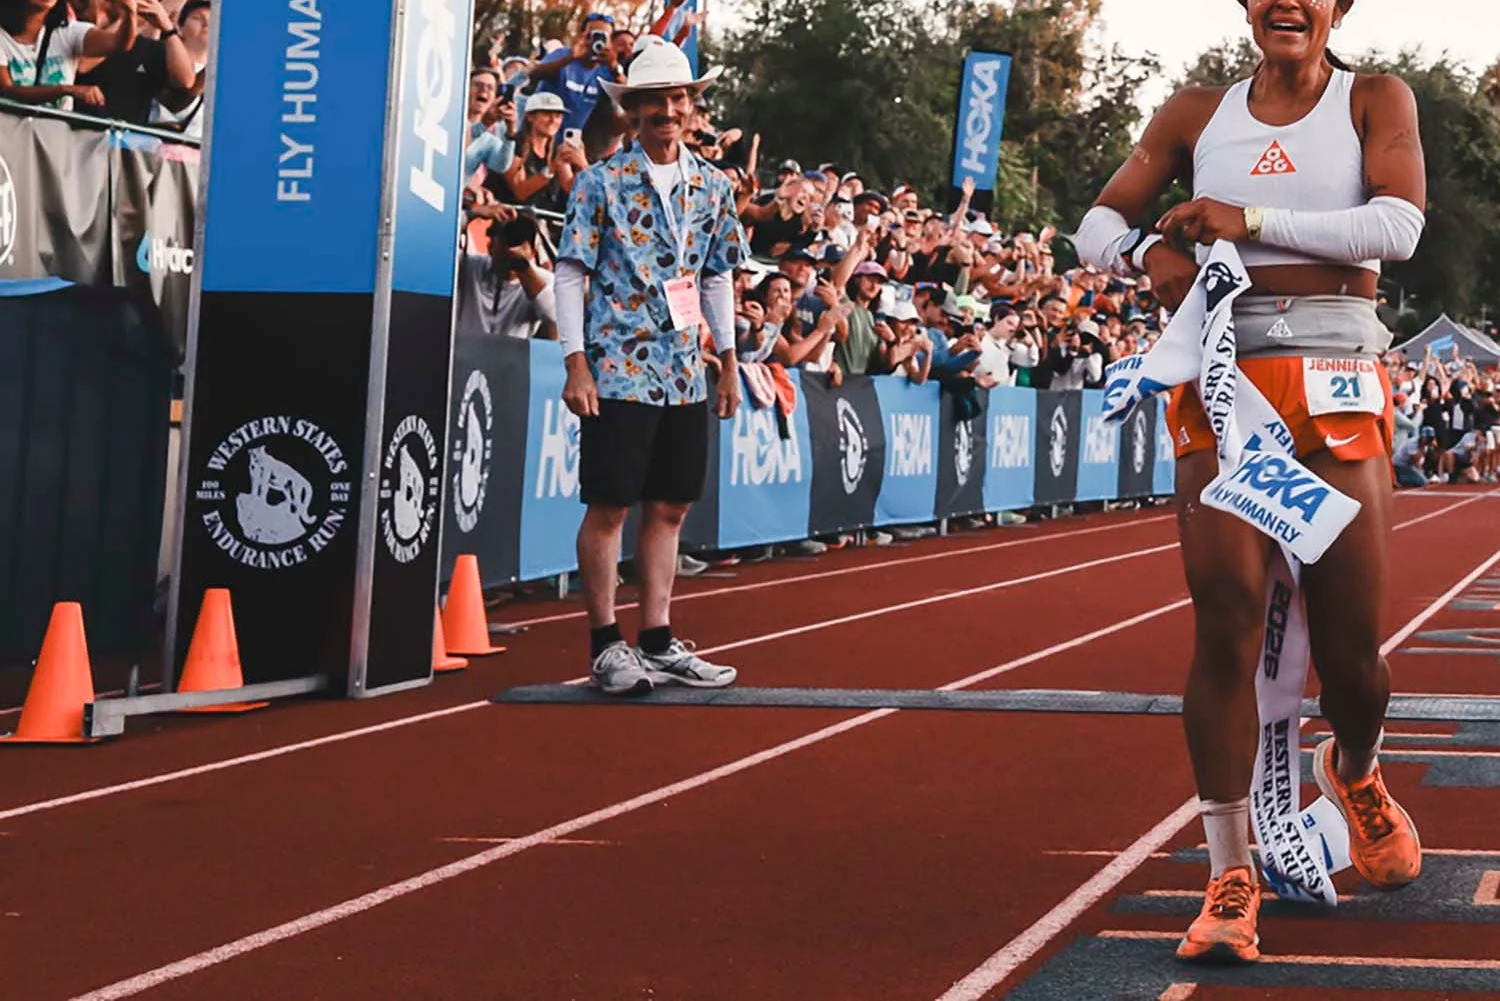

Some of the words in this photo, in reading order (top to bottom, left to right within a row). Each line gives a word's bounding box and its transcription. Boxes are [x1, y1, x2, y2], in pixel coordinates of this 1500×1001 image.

[961, 59, 1001, 173] HOKA
[277, 134, 313, 201] FLY
[1330, 376, 1361, 398] 21
[208, 415, 292, 472] WESTERN
[293, 418, 348, 475] STATES
[889, 413, 933, 476] HOKA
[992, 415, 1029, 468] HOKA
[196, 490, 226, 500] MILES
[202, 480, 220, 490] 100
[202, 510, 307, 569] ENDURANCE
[1274, 519, 1301, 543] FLY
[1262, 722, 1286, 846] ENDURANCE
[1273, 719, 1292, 816] WESTERN
[1282, 821, 1324, 891] STATES
